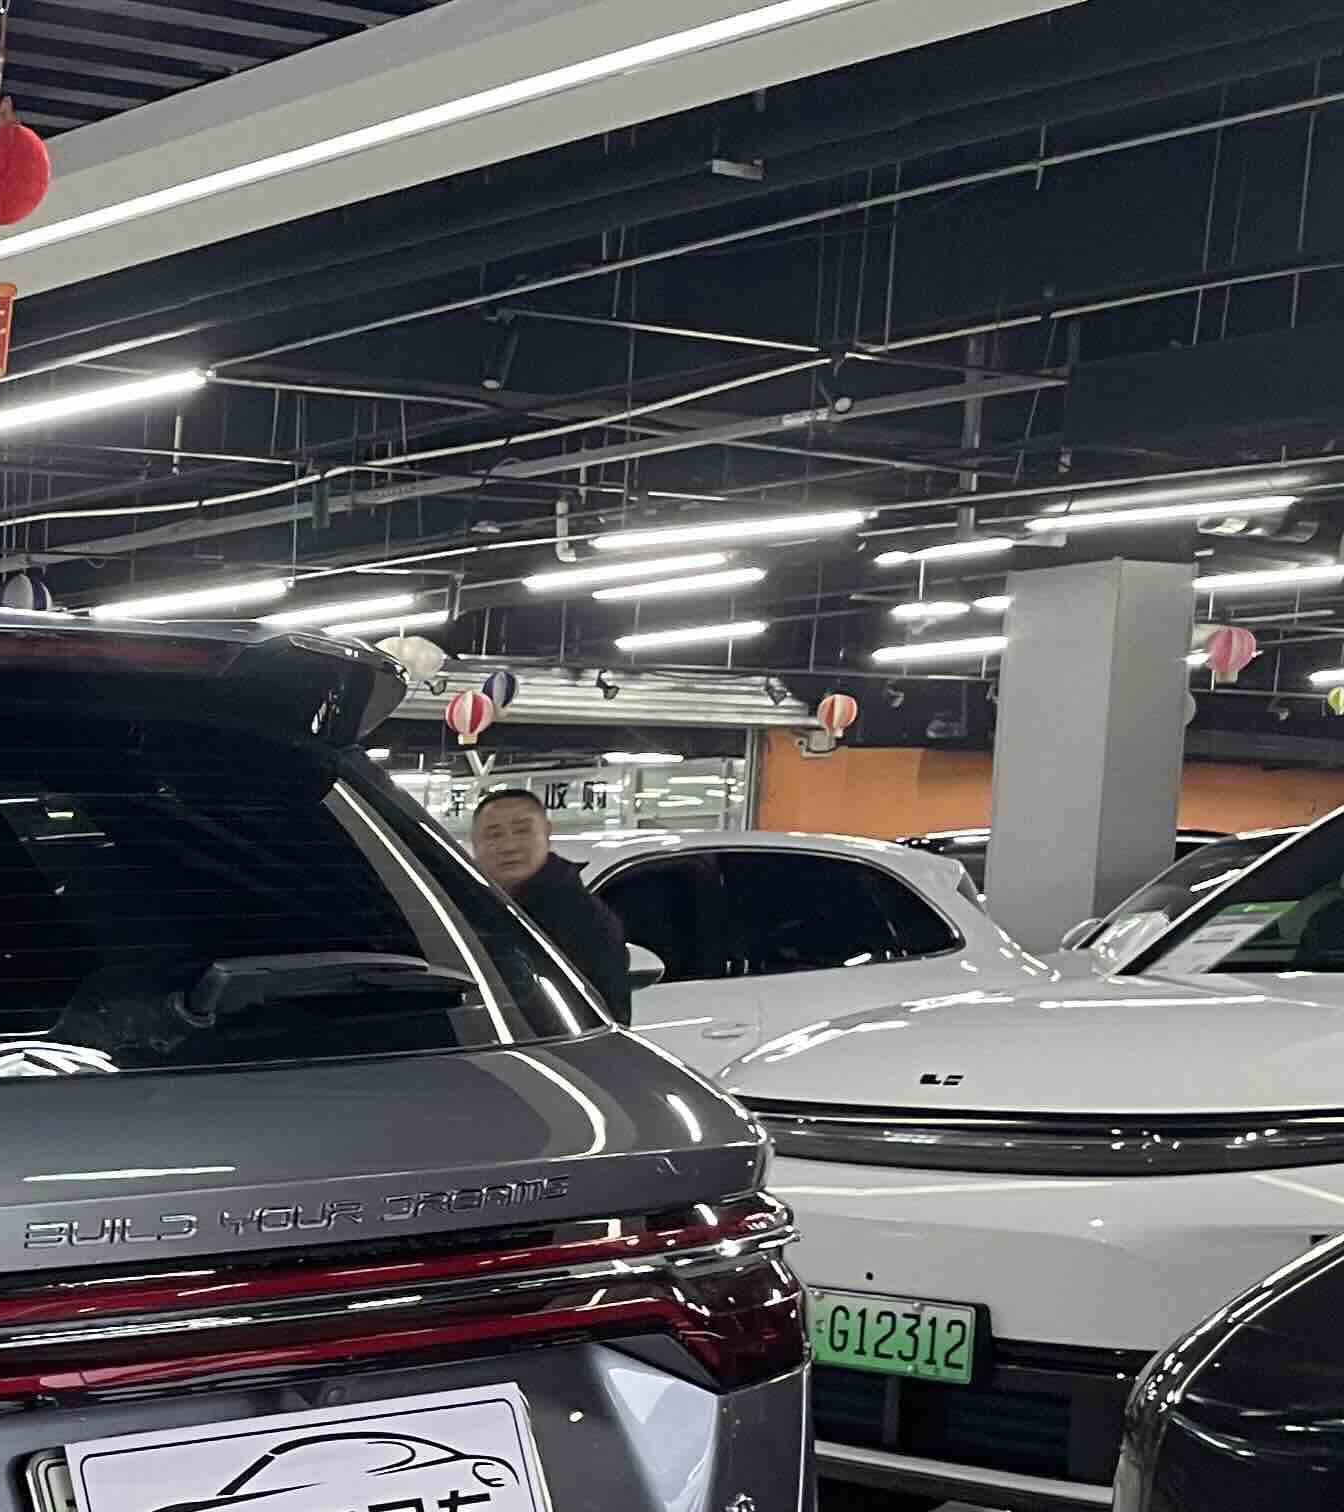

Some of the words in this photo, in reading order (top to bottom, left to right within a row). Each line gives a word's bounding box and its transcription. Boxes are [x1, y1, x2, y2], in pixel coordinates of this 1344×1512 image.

[24, 1214, 198, 1249] BUILD
[217, 1199, 363, 1238] YOUR
[828, 1305, 967, 1370] G12312
